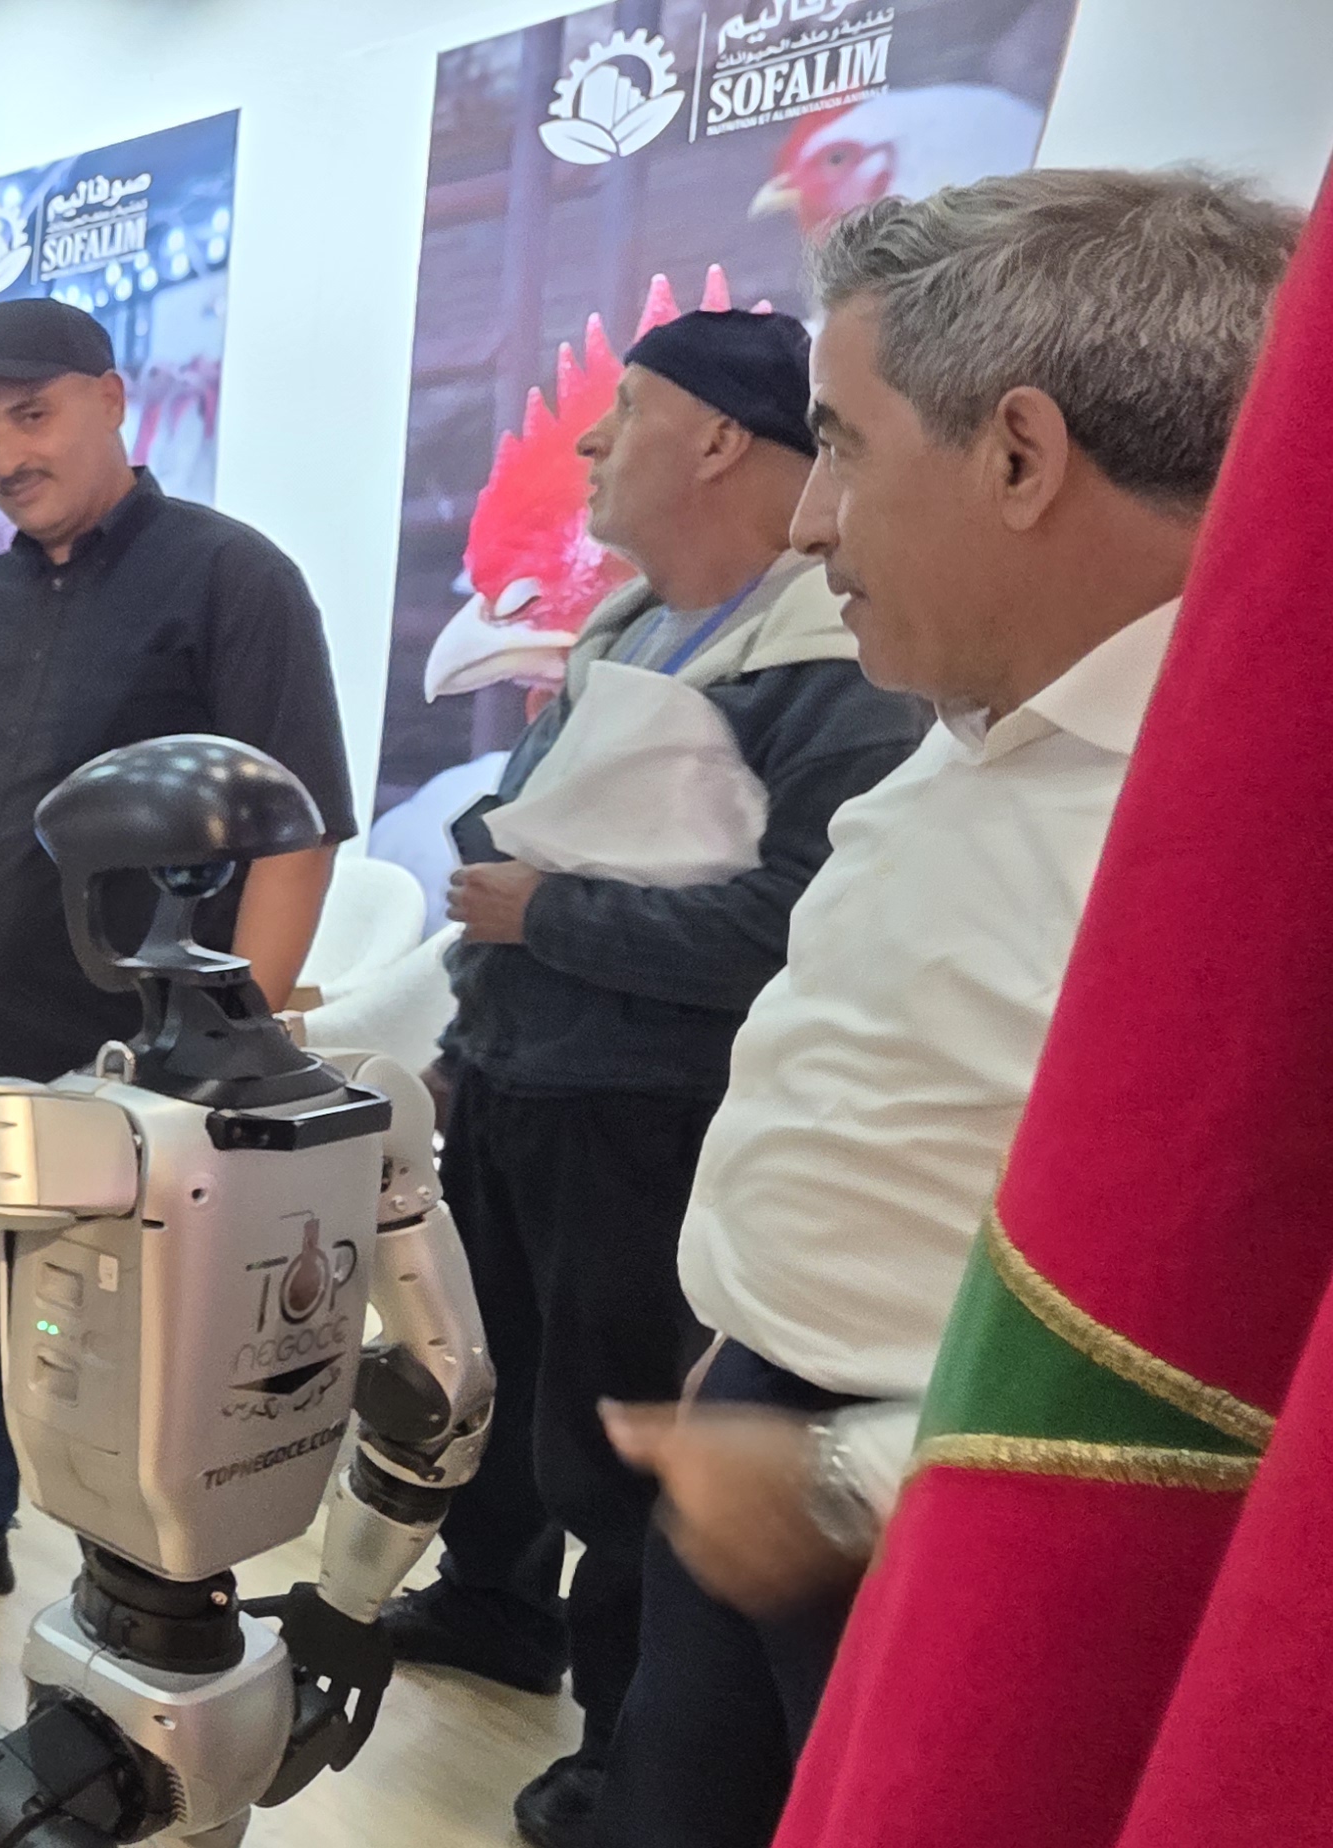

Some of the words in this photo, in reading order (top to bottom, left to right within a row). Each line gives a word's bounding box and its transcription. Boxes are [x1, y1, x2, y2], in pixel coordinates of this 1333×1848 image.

[707, 34, 892, 124] SOFALIM
[40, 216, 147, 272] SOFALIM
[245, 1238, 358, 1333] TOP
